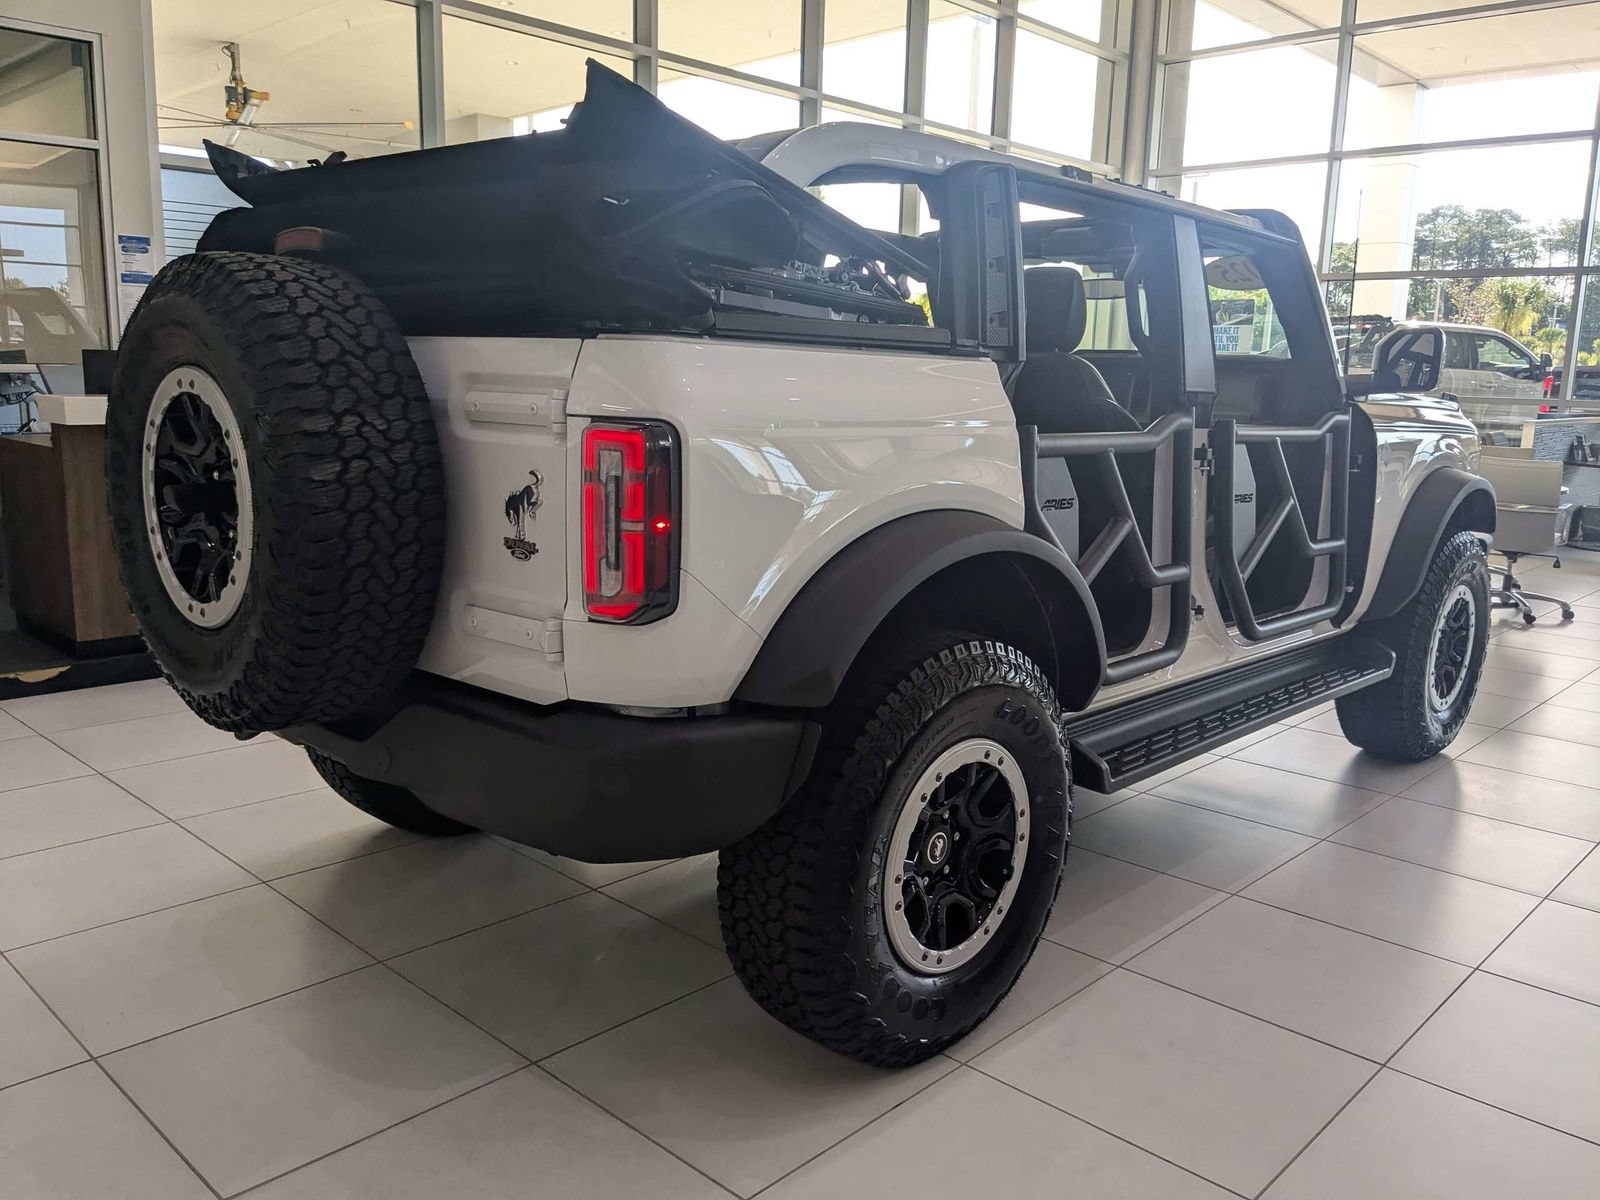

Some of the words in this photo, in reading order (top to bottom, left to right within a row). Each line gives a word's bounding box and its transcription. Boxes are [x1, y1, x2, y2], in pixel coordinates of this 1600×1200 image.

[1233, 326, 1240, 334] IT
[1225, 335, 1239, 343] YOU
[1231, 343, 1239, 352] IT
[1040, 497, 1075, 512] ARIES
